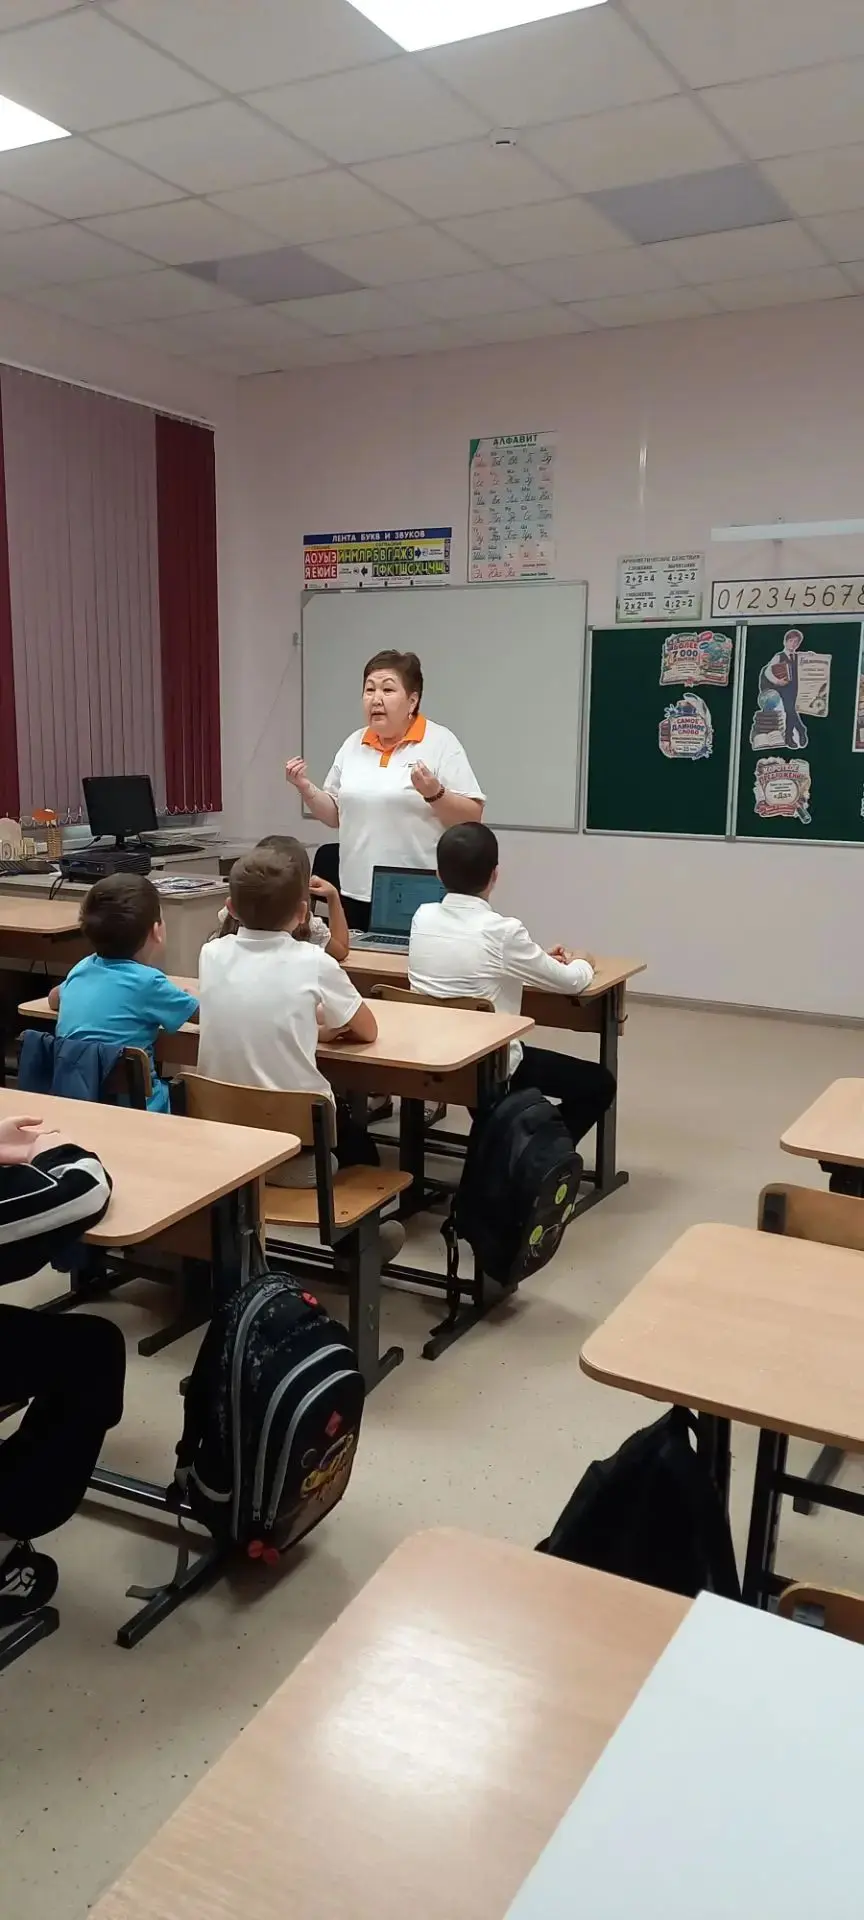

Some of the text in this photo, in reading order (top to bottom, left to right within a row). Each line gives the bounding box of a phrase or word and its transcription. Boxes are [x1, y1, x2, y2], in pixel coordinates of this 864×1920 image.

[493, 434, 538, 446] АЛФАВИТ
[332, 530, 425, 543] ЛЕНТА БУКВ И ЗВУКОВ
